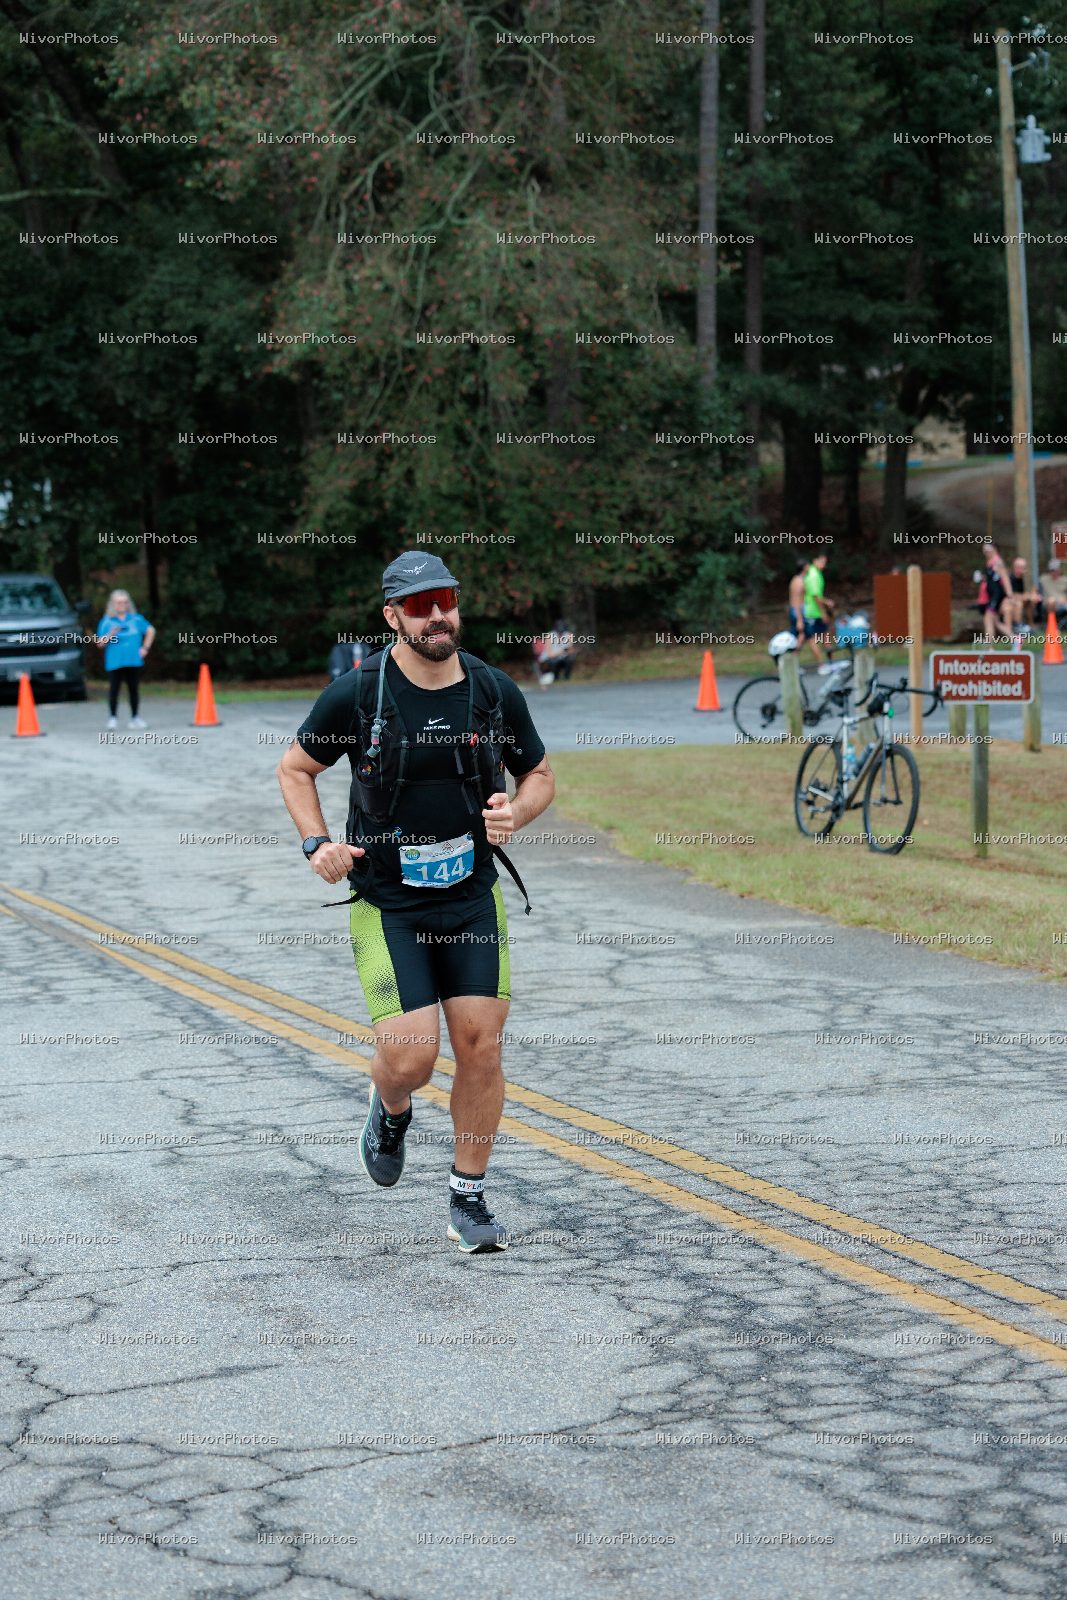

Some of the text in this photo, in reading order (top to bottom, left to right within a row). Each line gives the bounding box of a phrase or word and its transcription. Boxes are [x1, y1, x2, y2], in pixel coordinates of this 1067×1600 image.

[938, 659, 1025, 676] Intoxicants
[941, 680, 1023, 697] Prohibited
[416, 856, 466, 882] 144
